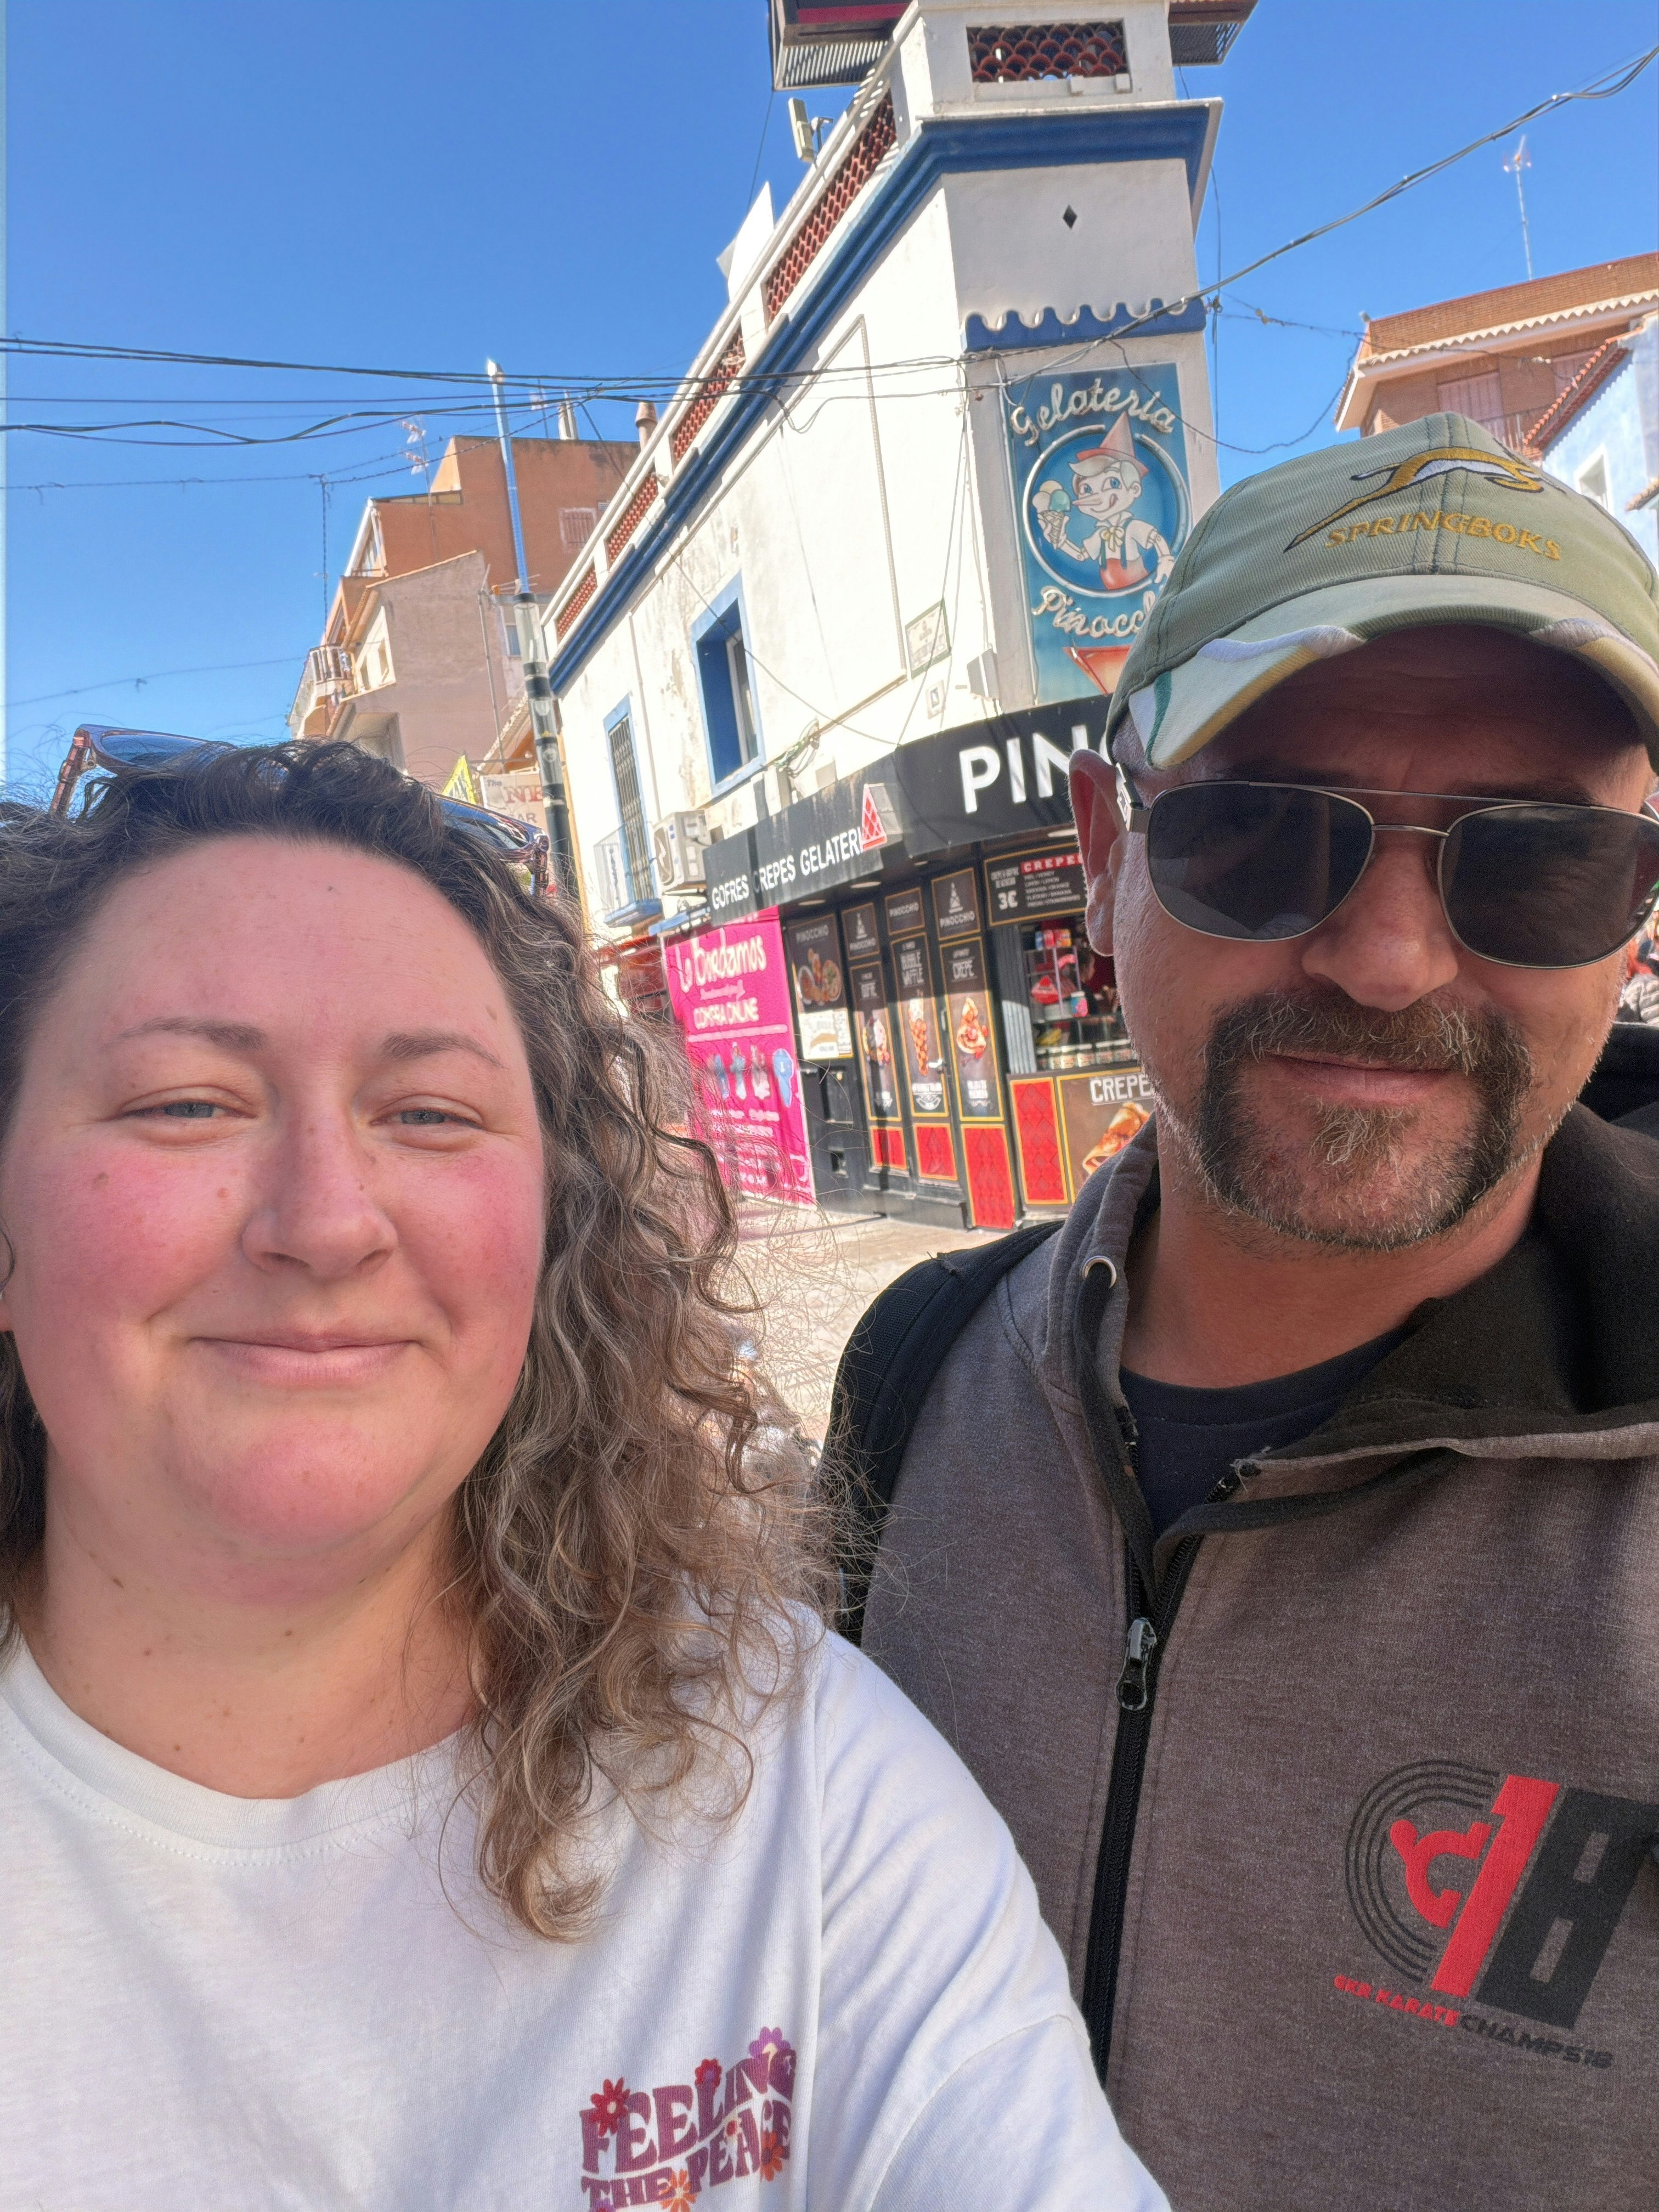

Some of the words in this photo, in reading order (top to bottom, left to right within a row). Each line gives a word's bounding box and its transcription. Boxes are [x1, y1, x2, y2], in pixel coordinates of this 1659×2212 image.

[1011, 377, 1176, 446] Gelateria
[1325, 510, 1561, 561] SPRINGBOKS
[959, 725, 1112, 814] PIN
[712, 874, 749, 911] GOFRES
[753, 855, 795, 893] CREPES
[800, 826, 863, 877] GELATERI
[889, 902, 919, 917] PINOCCHIO
[939, 911, 975, 928] PINOCCHIO
[998, 890, 1018, 910] 3€
[1090, 1073, 1154, 1103] CREPE
[1375, 1988, 1460, 2027] KARATE
[579, 2049, 797, 2175] FEELING
